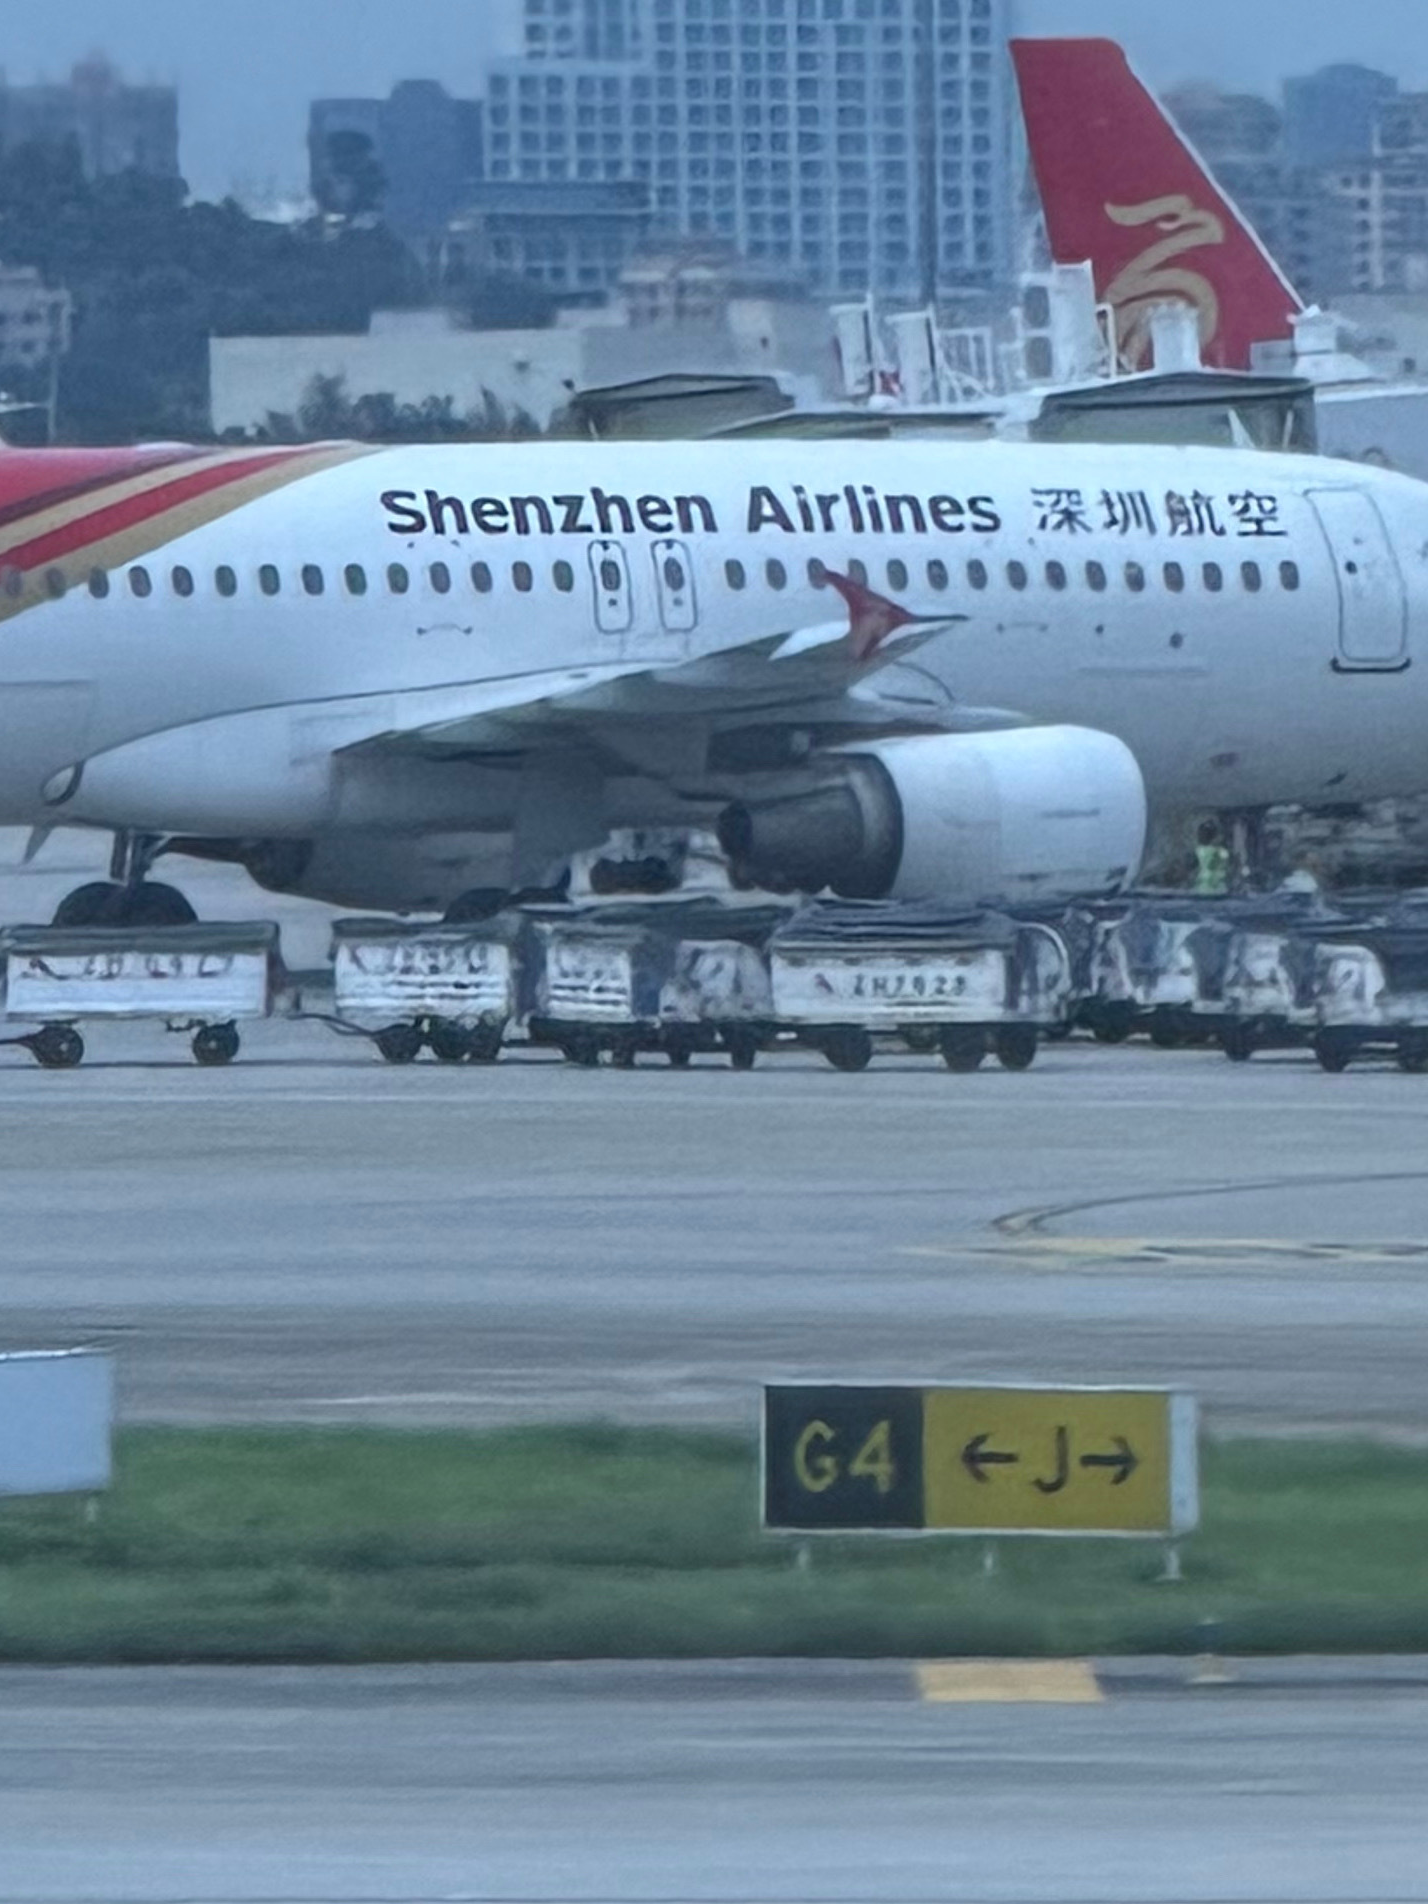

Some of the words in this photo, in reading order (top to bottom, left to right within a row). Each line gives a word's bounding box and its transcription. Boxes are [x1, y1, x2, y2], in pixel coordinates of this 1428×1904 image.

[378, 486, 719, 537] Shenzhen
[747, 483, 1002, 536] Airlines
[1030, 487, 1289, 539] 深圳航空
[795, 1420, 893, 1494] G4
[1033, 1426, 1068, 1494] J
